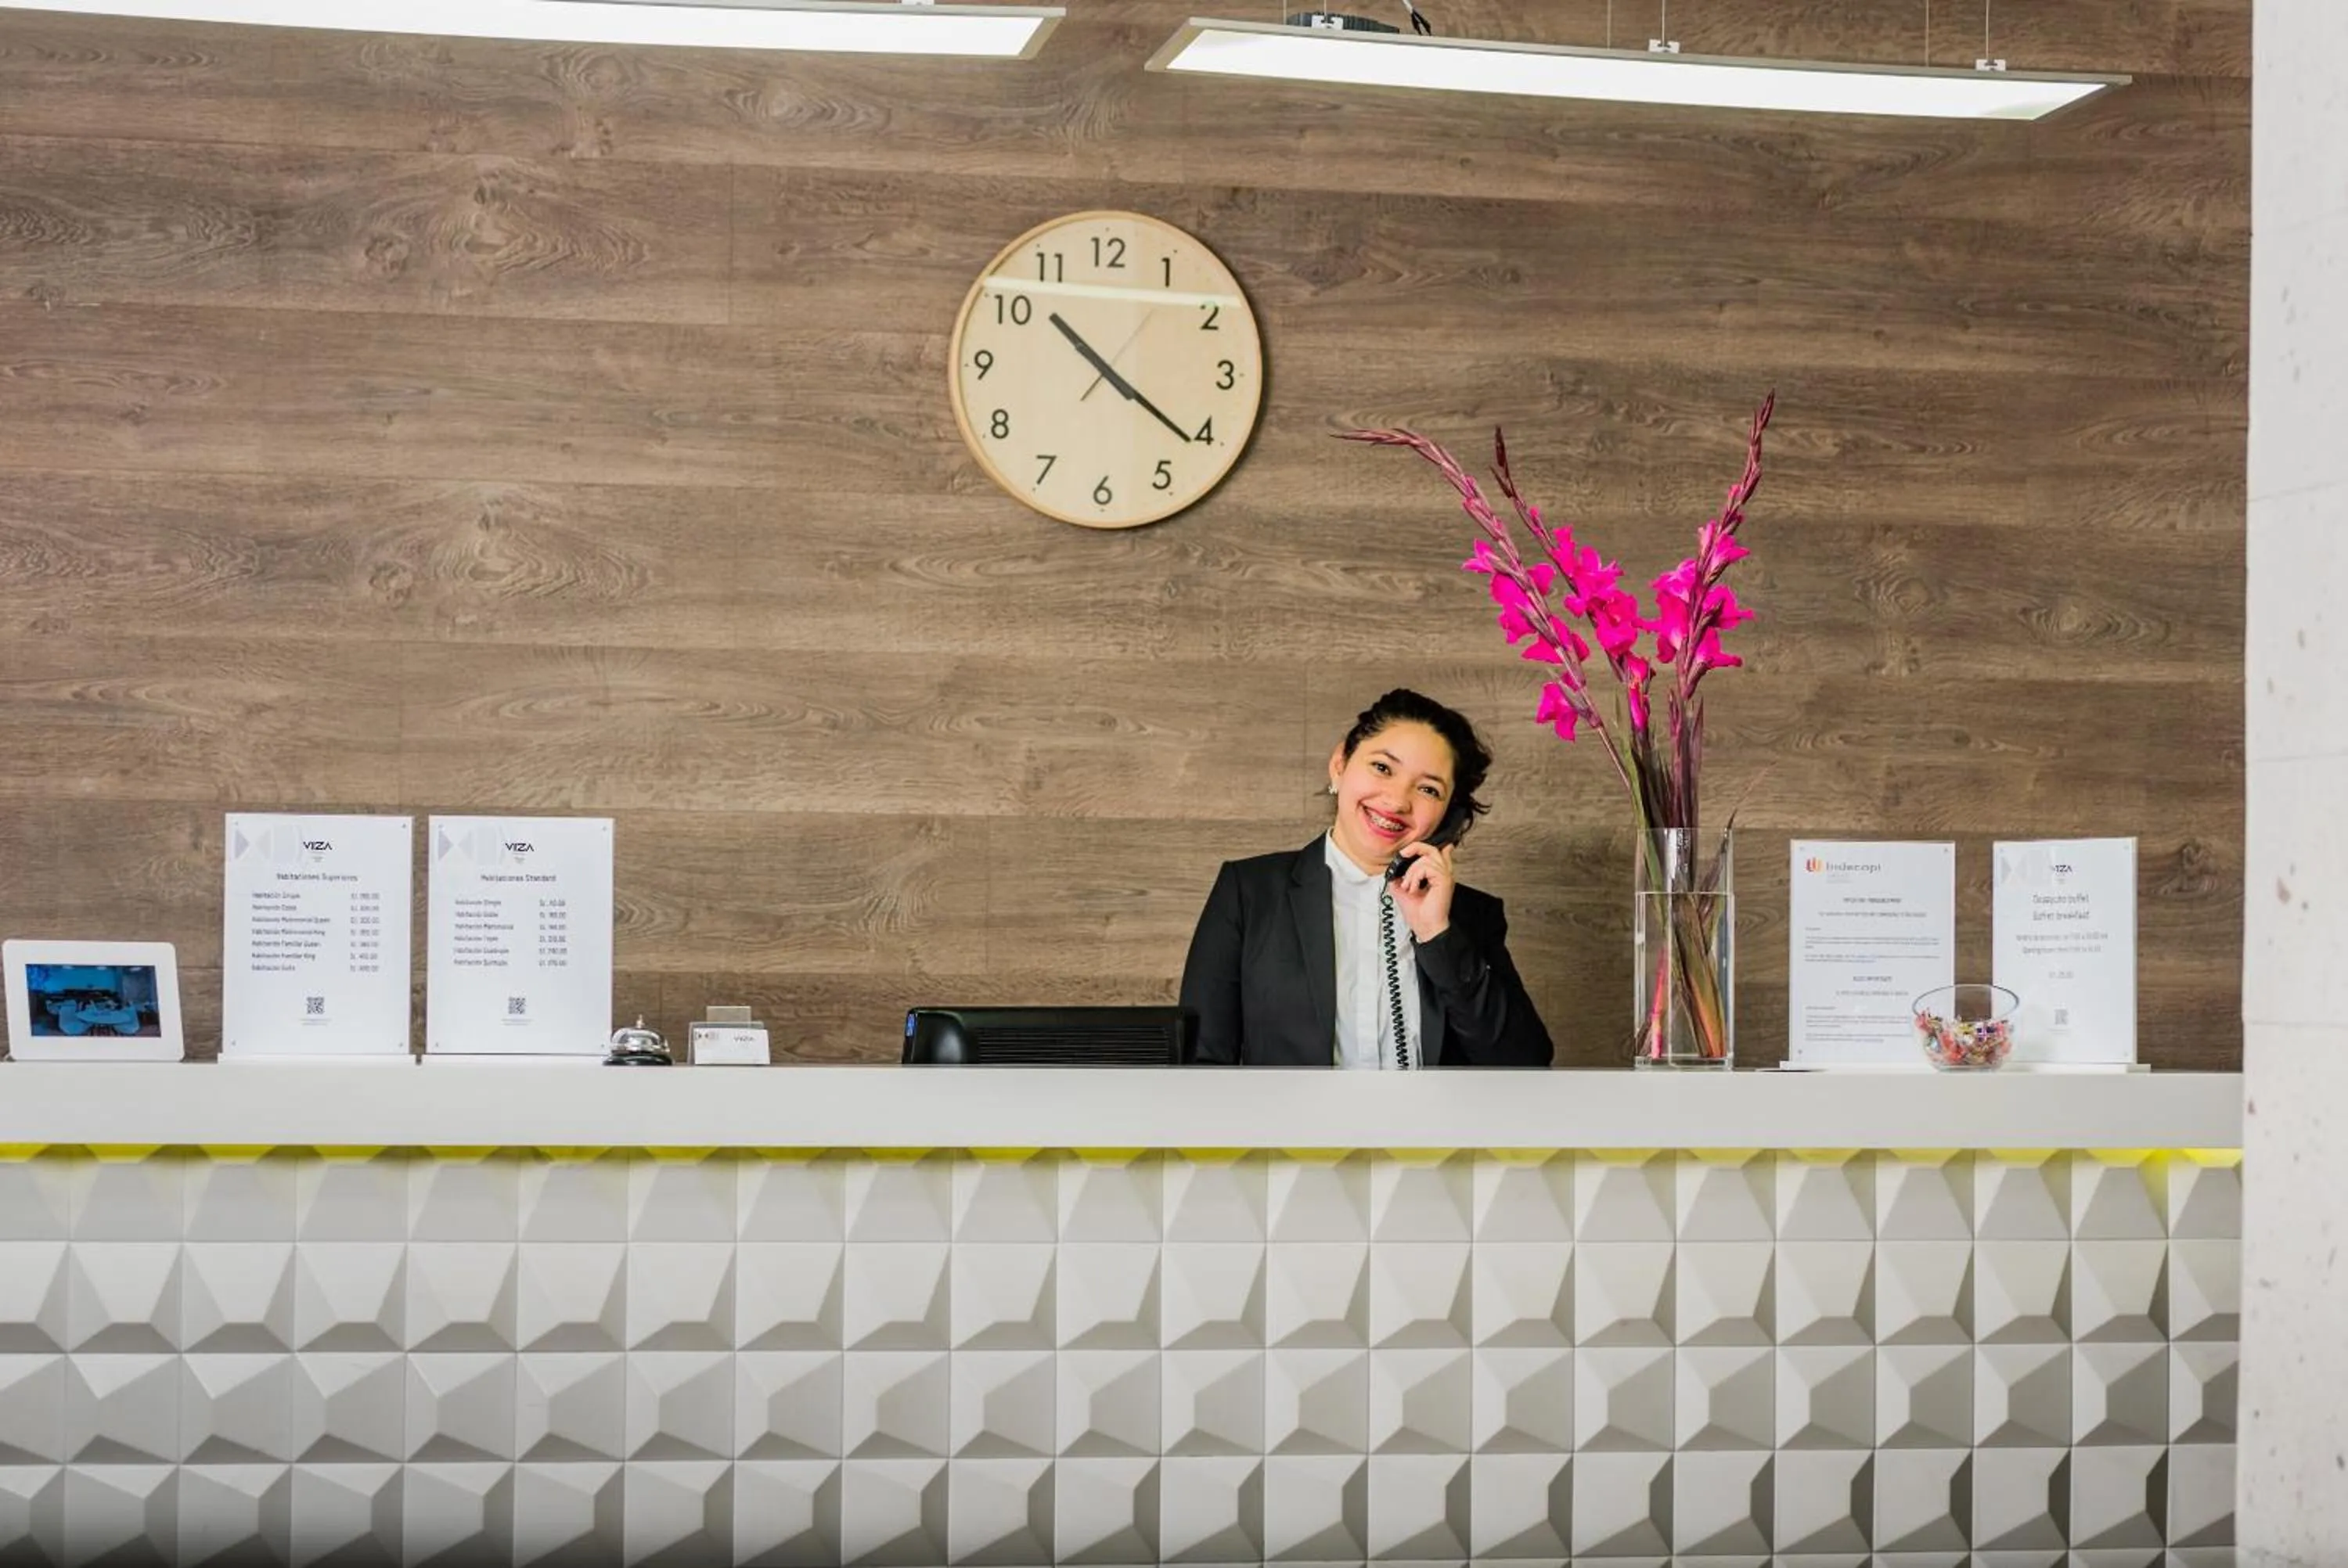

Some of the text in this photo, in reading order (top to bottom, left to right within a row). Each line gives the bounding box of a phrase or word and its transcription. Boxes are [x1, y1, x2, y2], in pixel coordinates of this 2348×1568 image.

[1036, 253, 1063, 282] 11
[1091, 237, 1125, 268] 12
[1161, 258, 1171, 288] 1
[995, 294, 1032, 325] 10
[1200, 301, 1220, 330] 2
[974, 350, 994, 380] 9
[1215, 360, 1235, 390] 3
[991, 409, 1010, 439] 8
[1194, 416, 1215, 445] 4
[1036, 455, 1057, 485] 7
[1152, 460, 1172, 490] 5
[1093, 476, 1112, 505] 6
[303, 841, 333, 851] VIZA
[505, 843, 535, 852] VIZA
